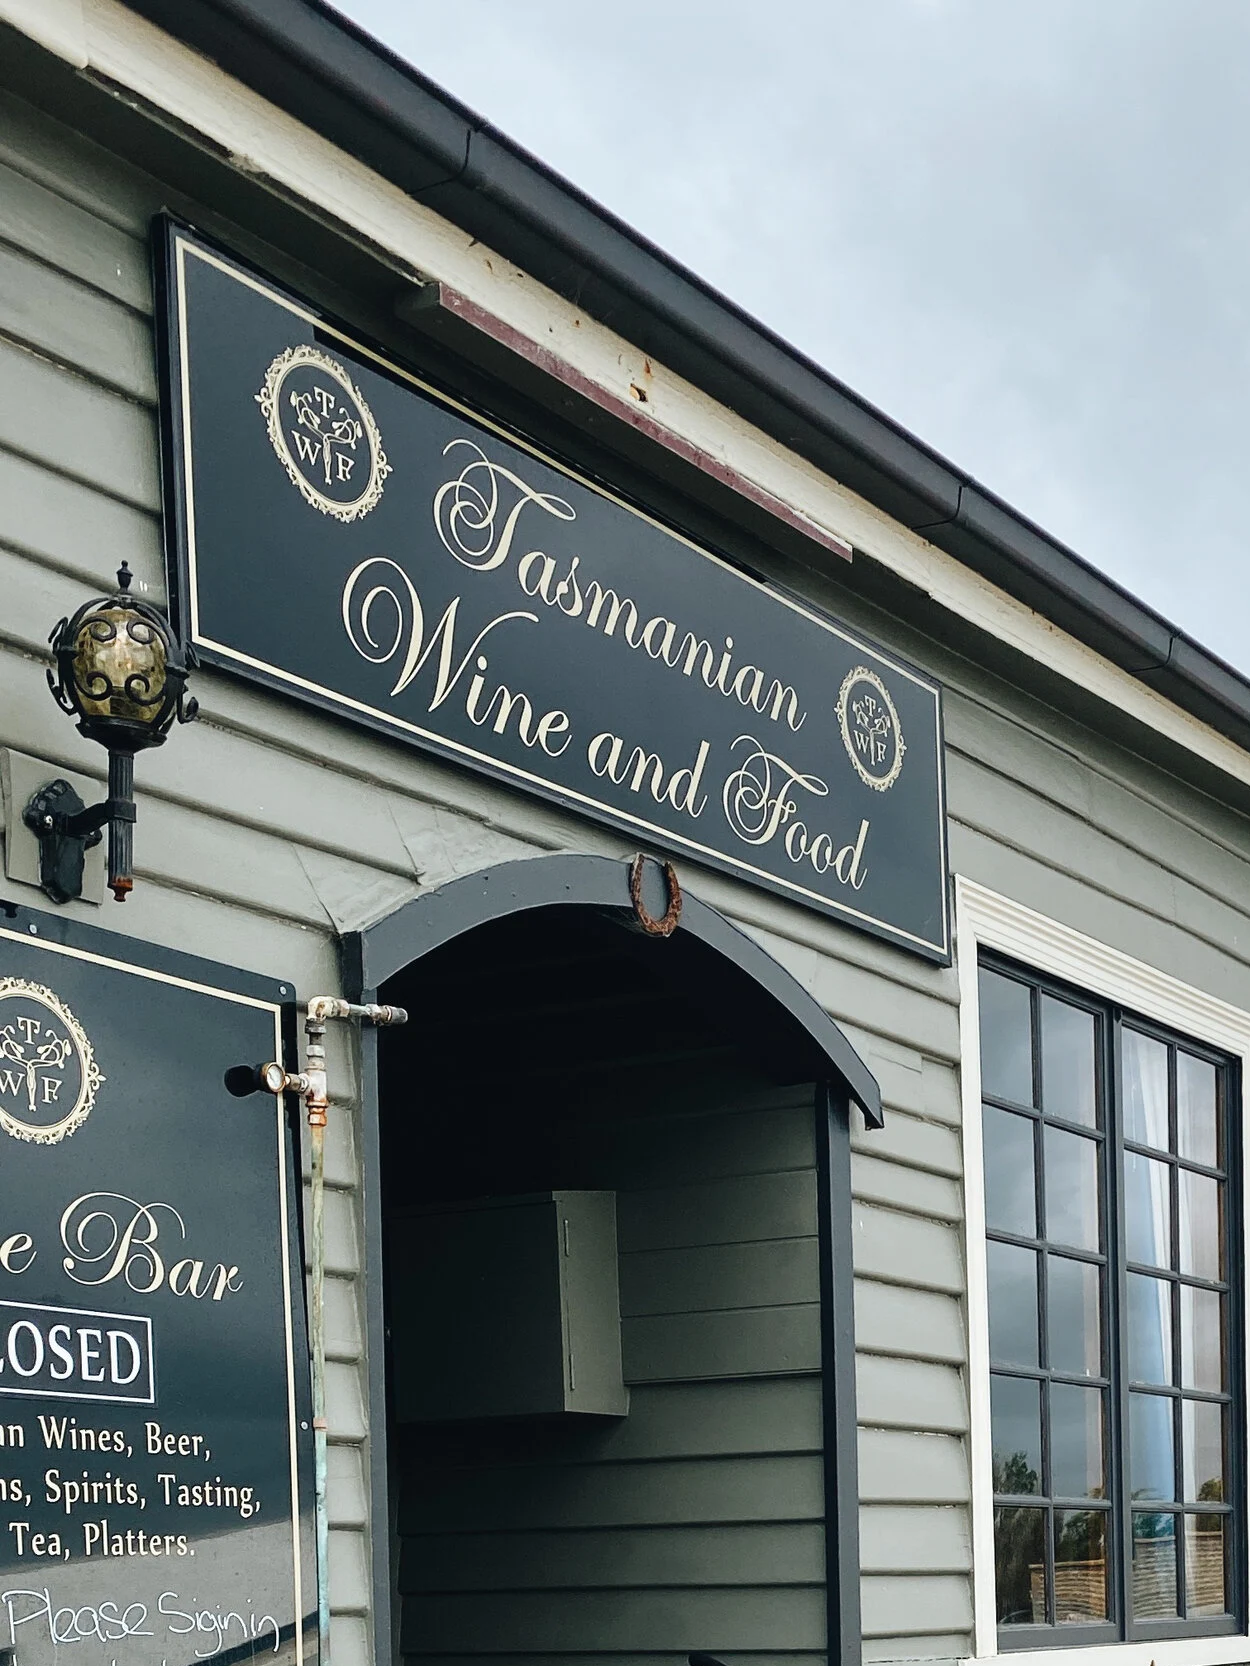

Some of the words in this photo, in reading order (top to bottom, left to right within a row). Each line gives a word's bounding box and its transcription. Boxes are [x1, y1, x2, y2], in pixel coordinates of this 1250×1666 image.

[314, 386, 335, 418] T
[291, 430, 322, 466] W
[434, 439, 806, 733] Tasmanian
[342, 557, 572, 757] Wine
[588, 739, 707, 819] and
[722, 734, 869, 891] Food
[17, 1016, 41, 1045] T
[60, 1192, 243, 1300] Bar
[0, 1320, 141, 1385] OSED
[36, 1415, 133, 1458] Wines,
[144, 1422, 211, 1462] Beer,
[45, 1469, 146, 1514] Spirits,
[157, 1474, 261, 1518] Tasting,
[9, 1522, 70, 1561] Tea,
[82, 1519, 195, 1557] Platters.
[1, 1587, 154, 1644] Please
